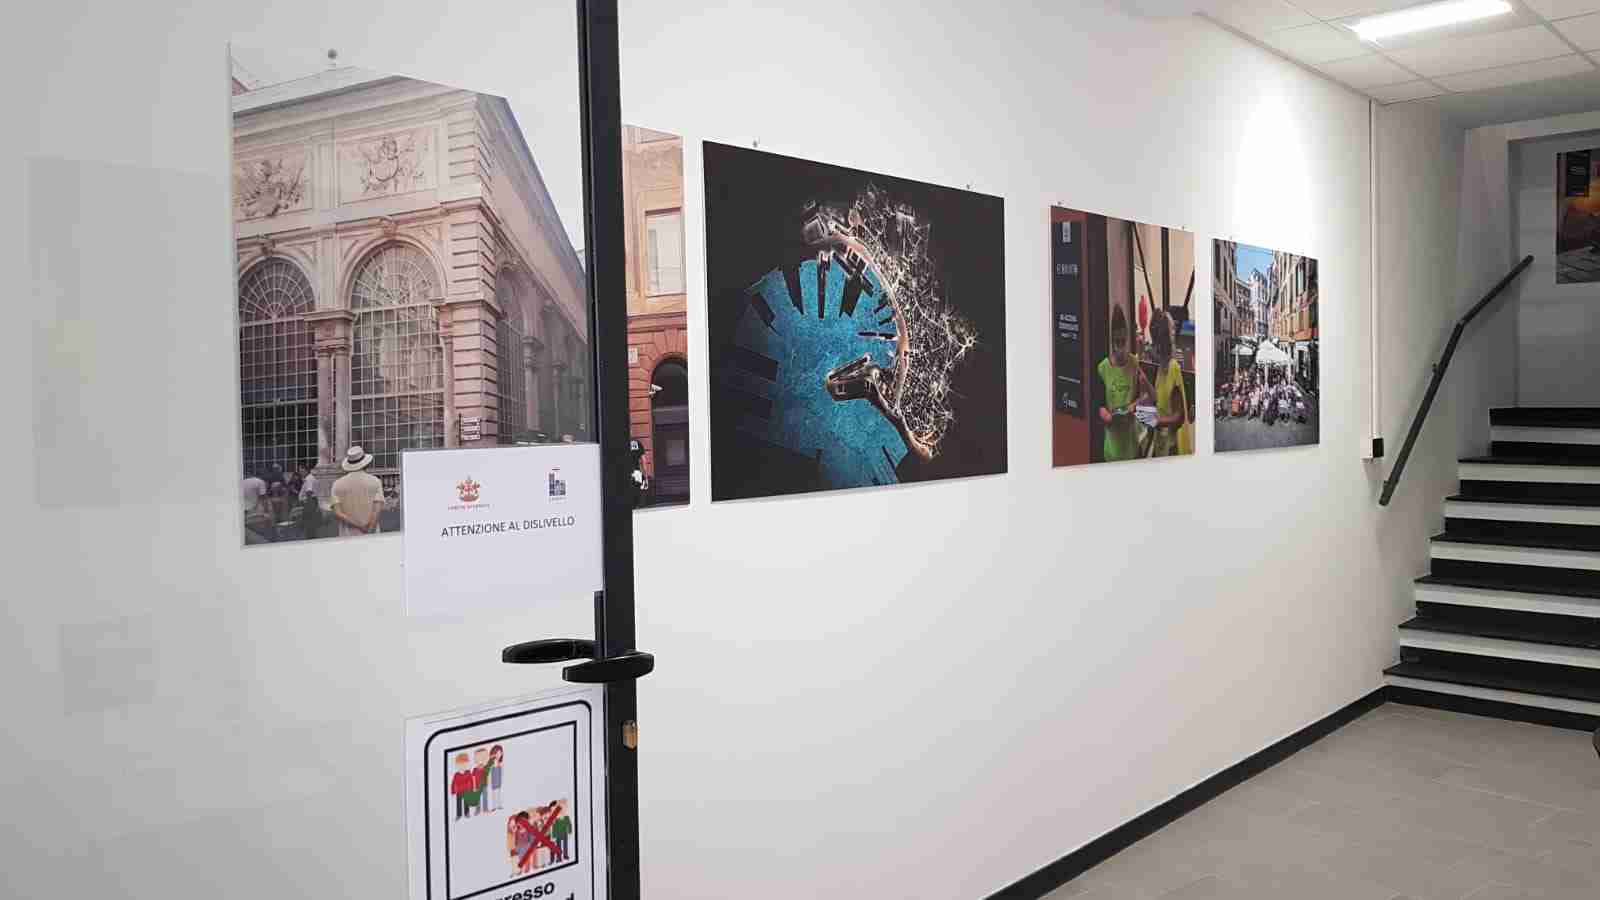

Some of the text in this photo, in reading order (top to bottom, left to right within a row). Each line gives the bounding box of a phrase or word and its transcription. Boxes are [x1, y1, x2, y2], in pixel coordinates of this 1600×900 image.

[441, 516, 575, 537] ATTENZIONE AL DISLIVELLO
[497, 882, 555, 900] esso
